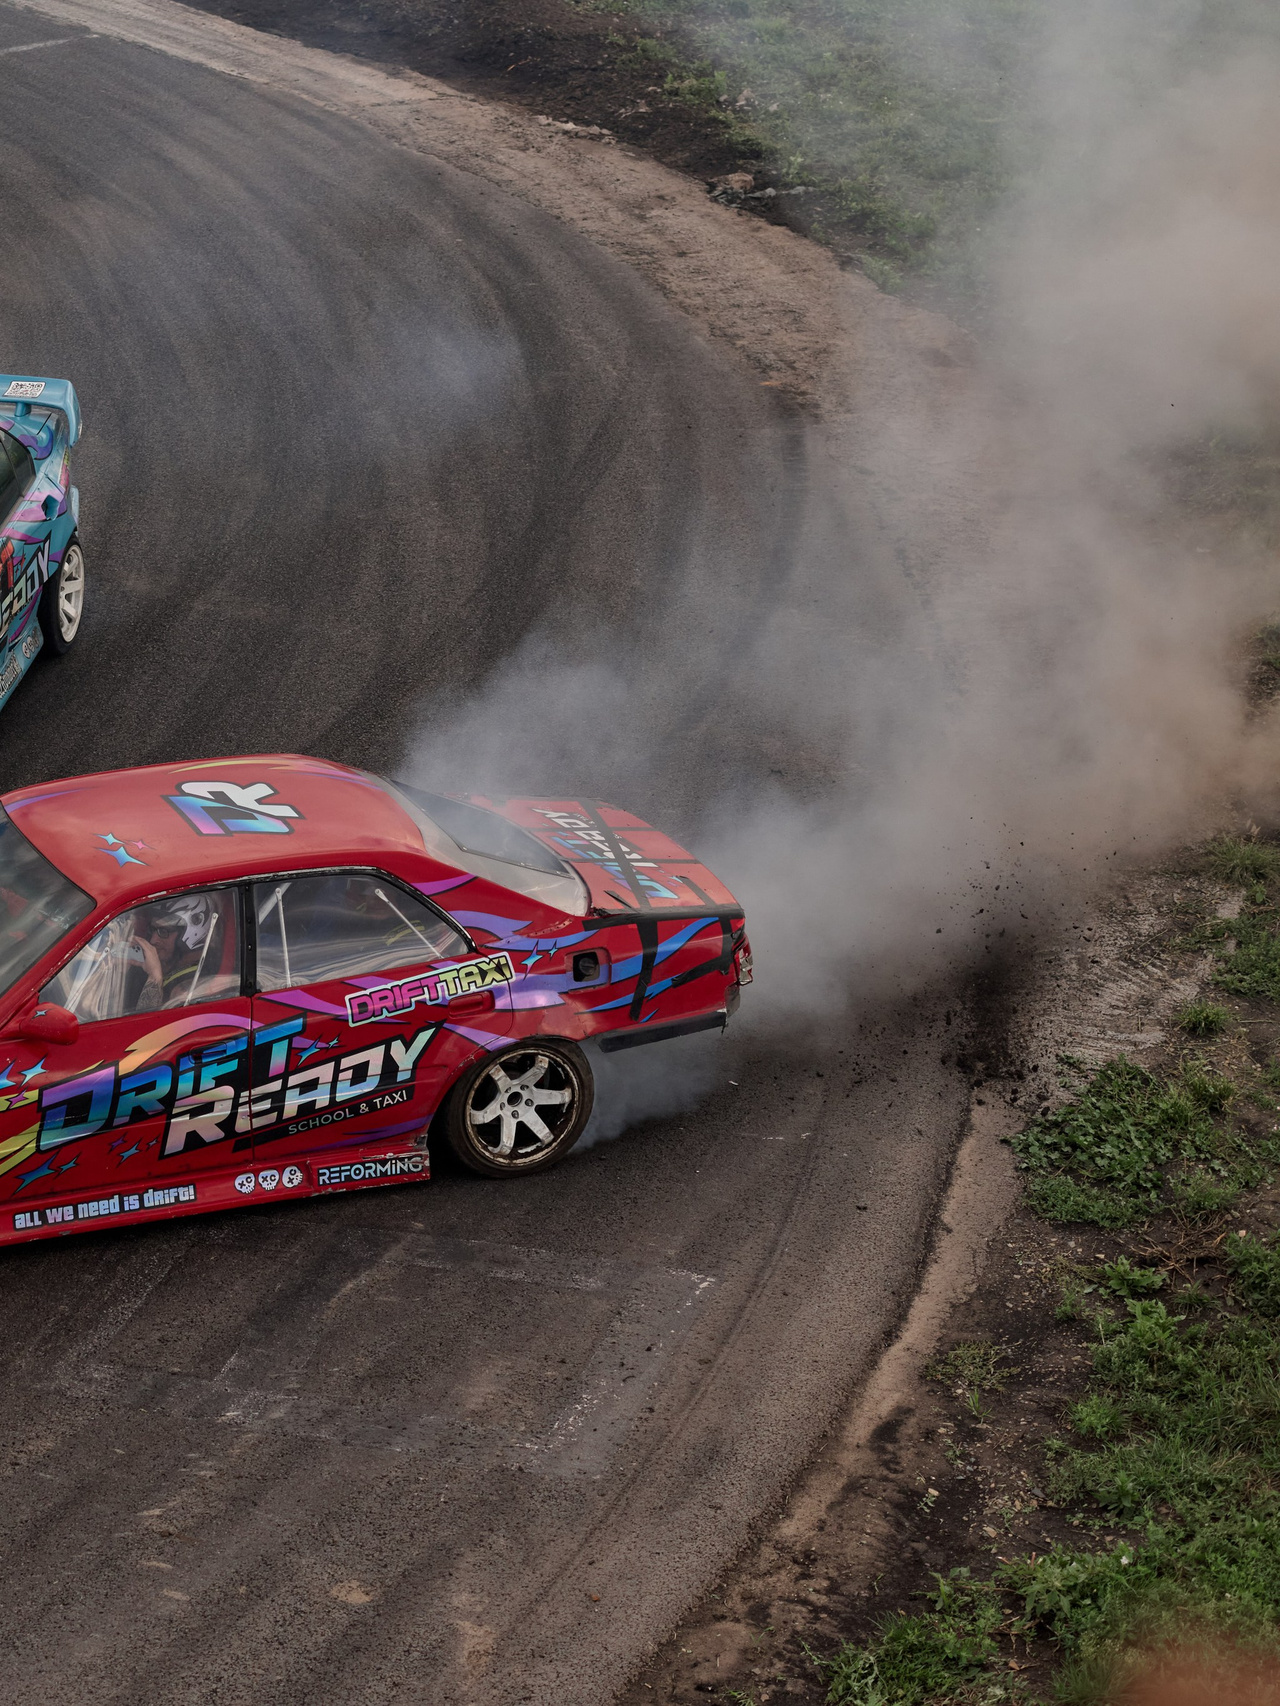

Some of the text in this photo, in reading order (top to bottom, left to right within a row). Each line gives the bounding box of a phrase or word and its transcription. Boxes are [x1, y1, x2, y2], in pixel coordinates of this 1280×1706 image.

[163, 1027, 437, 1156] READY
[288, 1089, 408, 1135] SCHOOL & TAXI
[45, 1205, 74, 1224] we
[77, 1195, 120, 1219] need
[123, 1196, 140, 1211] is
